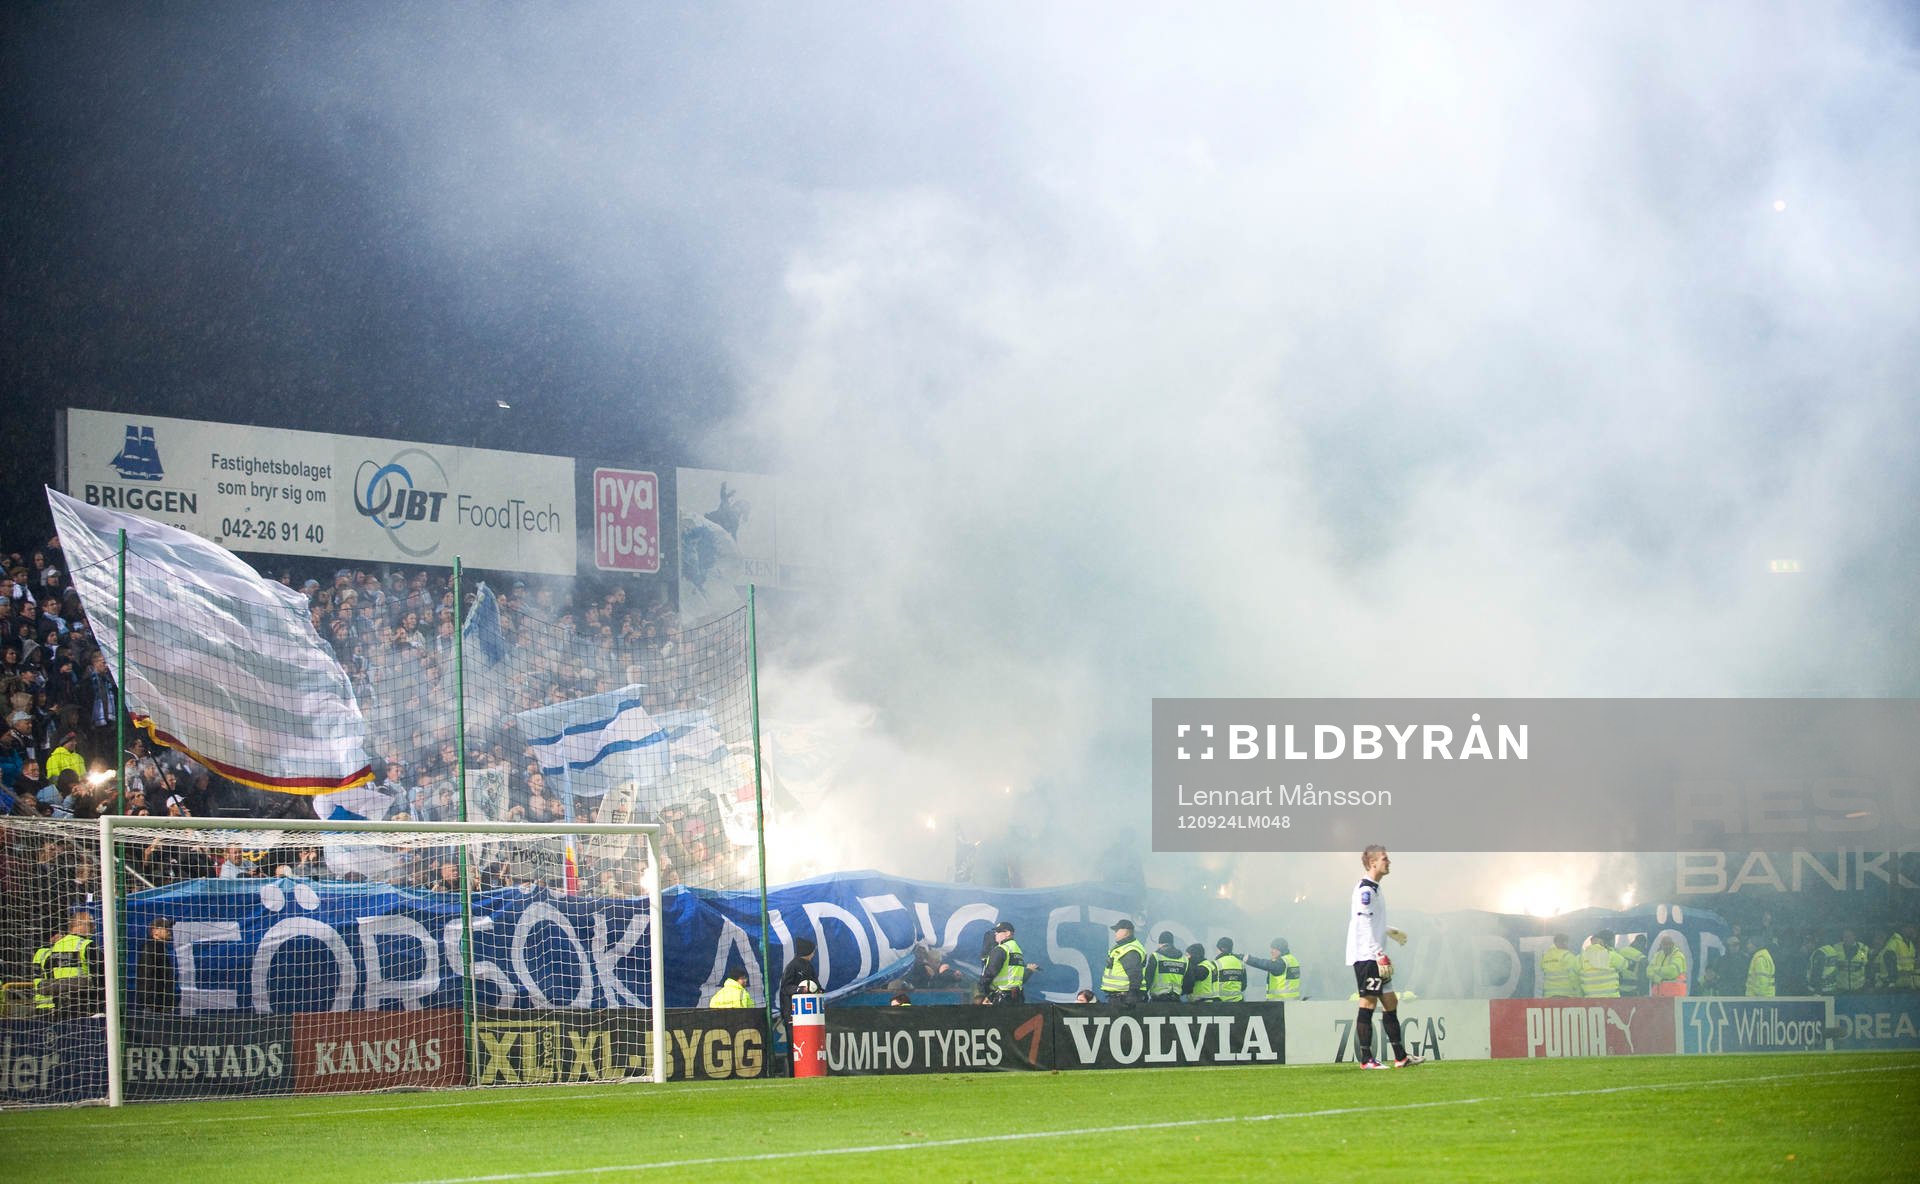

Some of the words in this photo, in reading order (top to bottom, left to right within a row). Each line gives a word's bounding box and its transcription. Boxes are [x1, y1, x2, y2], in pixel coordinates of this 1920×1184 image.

[212, 454, 332, 482] Fastighetsbolaget
[85, 484, 197, 514] BRIGGEN
[217, 482, 247, 496] som
[251, 482, 279, 502] bryr
[282, 485, 302, 504] sig
[306, 489, 327, 502] om
[388, 488, 448, 522] JBT
[600, 477, 654, 519] nya
[222, 518, 277, 540] 042-26
[282, 522, 299, 542] 91
[305, 524, 324, 544] 40
[458, 495, 561, 533] FoodTech
[1366, 978, 1382, 991] 27
[1064, 1015, 1278, 1064] VOLVIA
[1526, 1007, 1607, 1058] PUMA
[1836, 1012, 1920, 1040] DREA
[126, 1042, 283, 1082] FRISTADS
[314, 1038, 442, 1076] KANSAS
[919, 1027, 1001, 1068] TYRES
